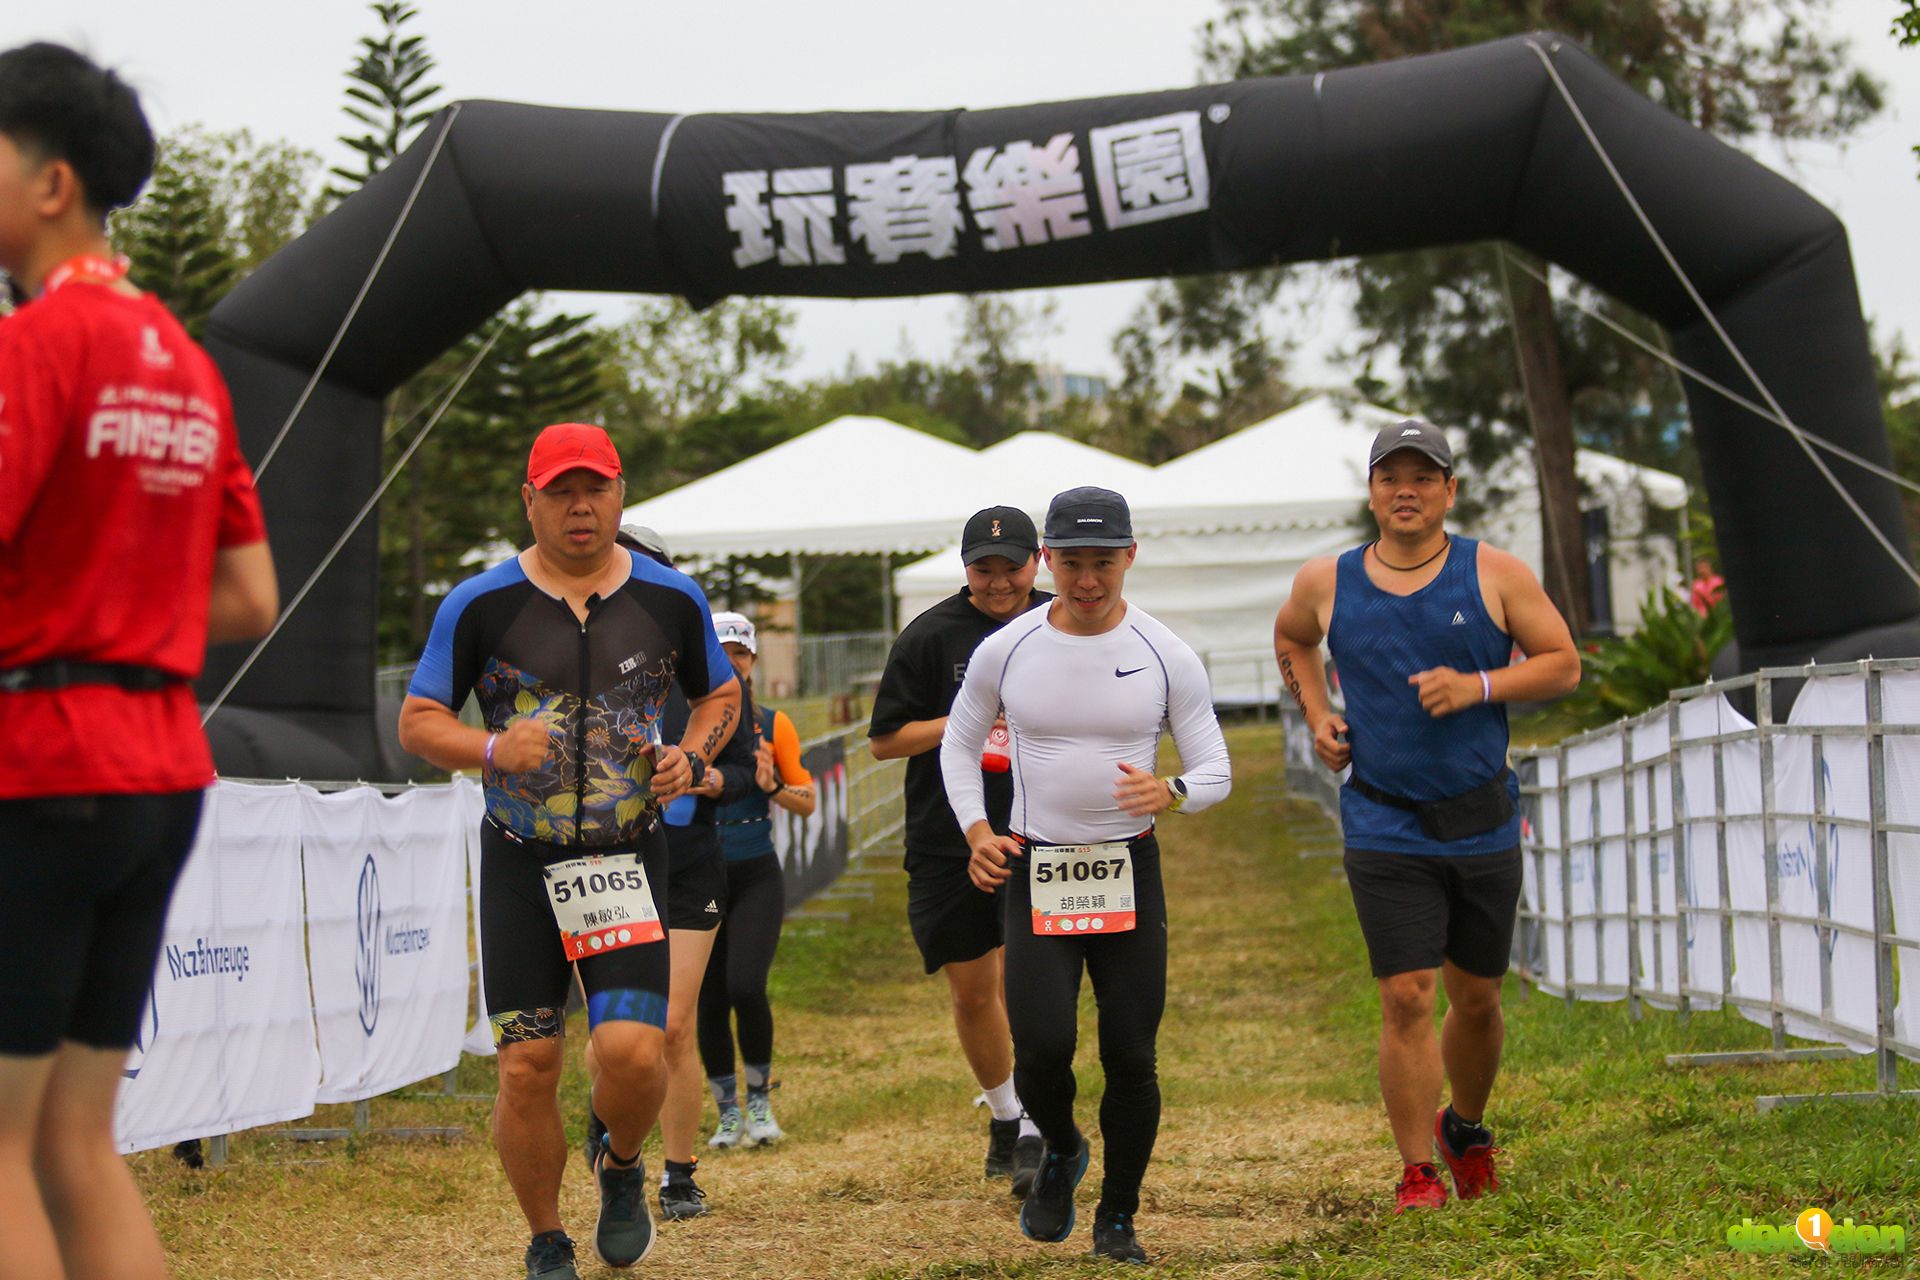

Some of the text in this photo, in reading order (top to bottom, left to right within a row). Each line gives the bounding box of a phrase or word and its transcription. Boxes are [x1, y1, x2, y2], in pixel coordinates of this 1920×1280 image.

[722, 111, 1210, 268] 玩賽樂園
[553, 870, 643, 904] 51065
[1036, 858, 1126, 884] 51067
